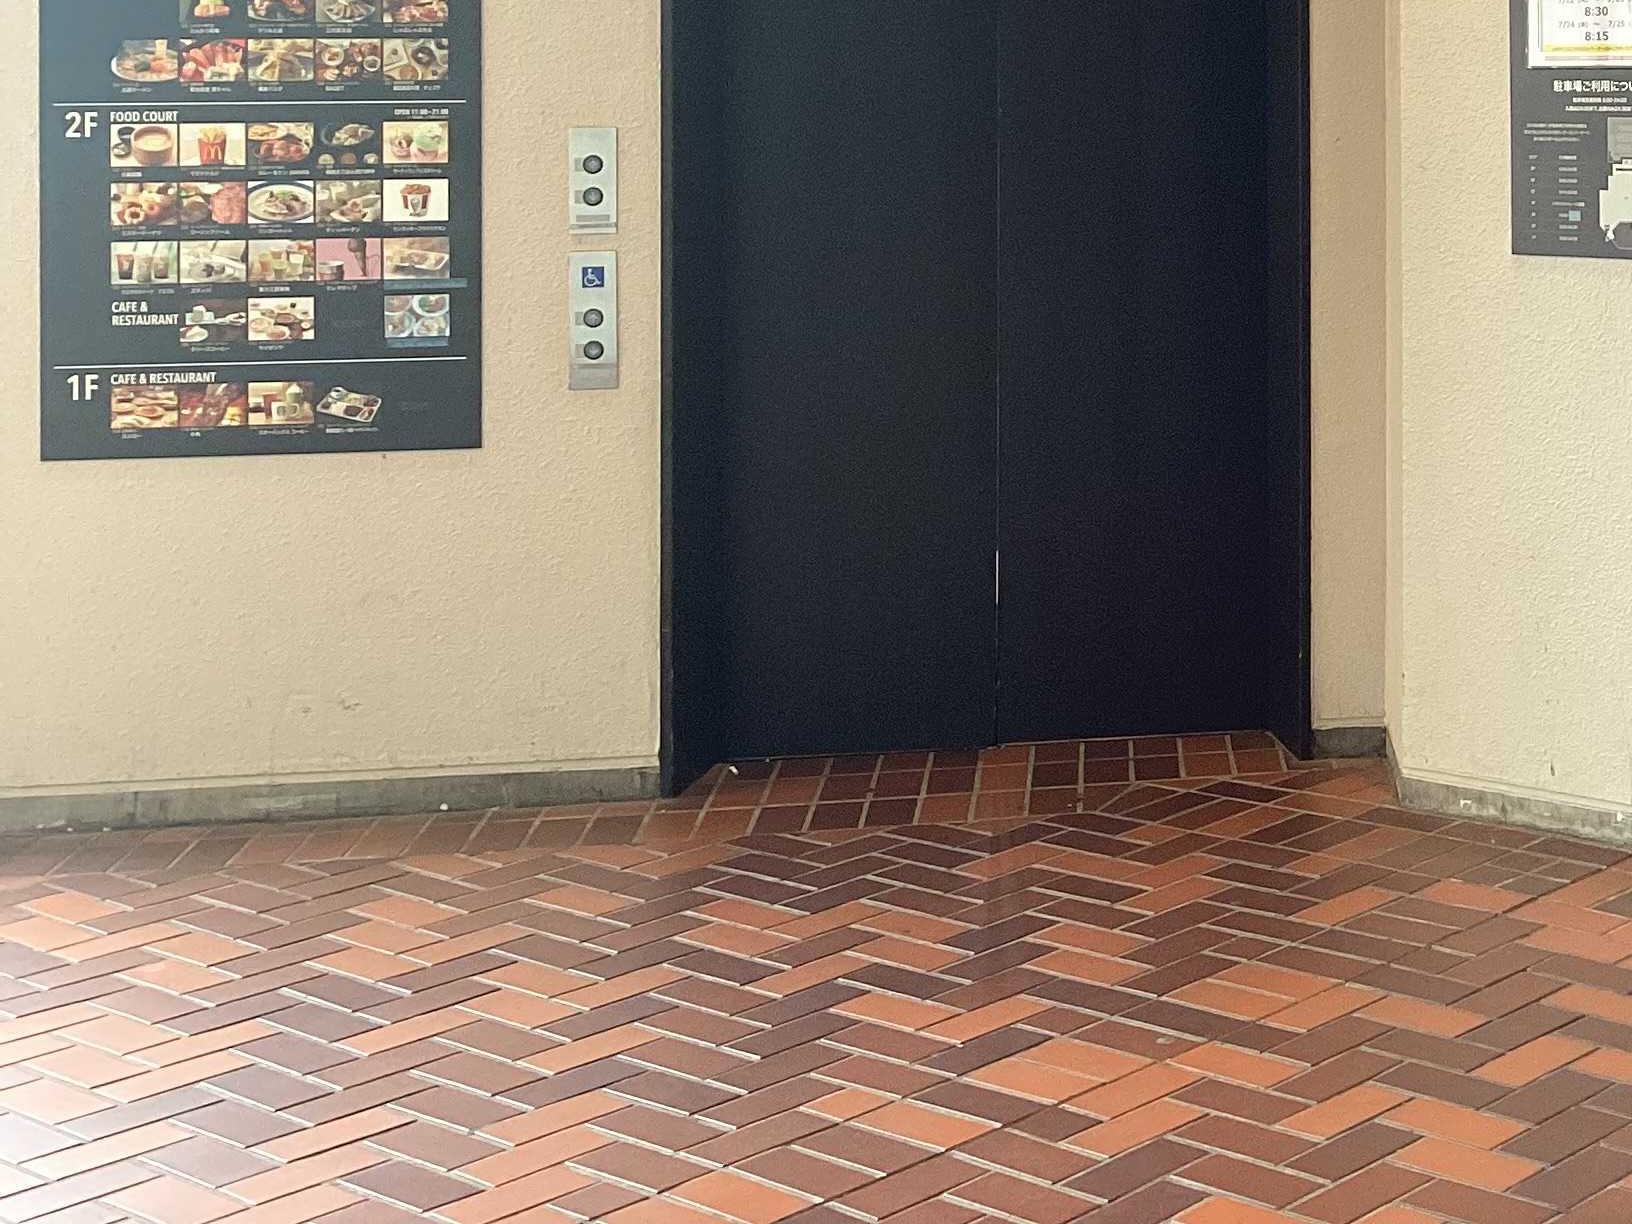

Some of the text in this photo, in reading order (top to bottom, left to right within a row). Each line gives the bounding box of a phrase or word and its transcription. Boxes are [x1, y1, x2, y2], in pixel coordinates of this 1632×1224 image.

[1584, 6, 1608, 16] 8:30
[1584, 31, 1609, 41] 8:15
[110, 111, 178, 122] FOOD COURT
[65, 111, 98, 138] 2F
[111, 301, 148, 313] CAFE &
[111, 314, 178, 326] RESTAURANT
[110, 372, 217, 384] CAFE & RESTAURANT
[66, 374, 99, 401] 1F
